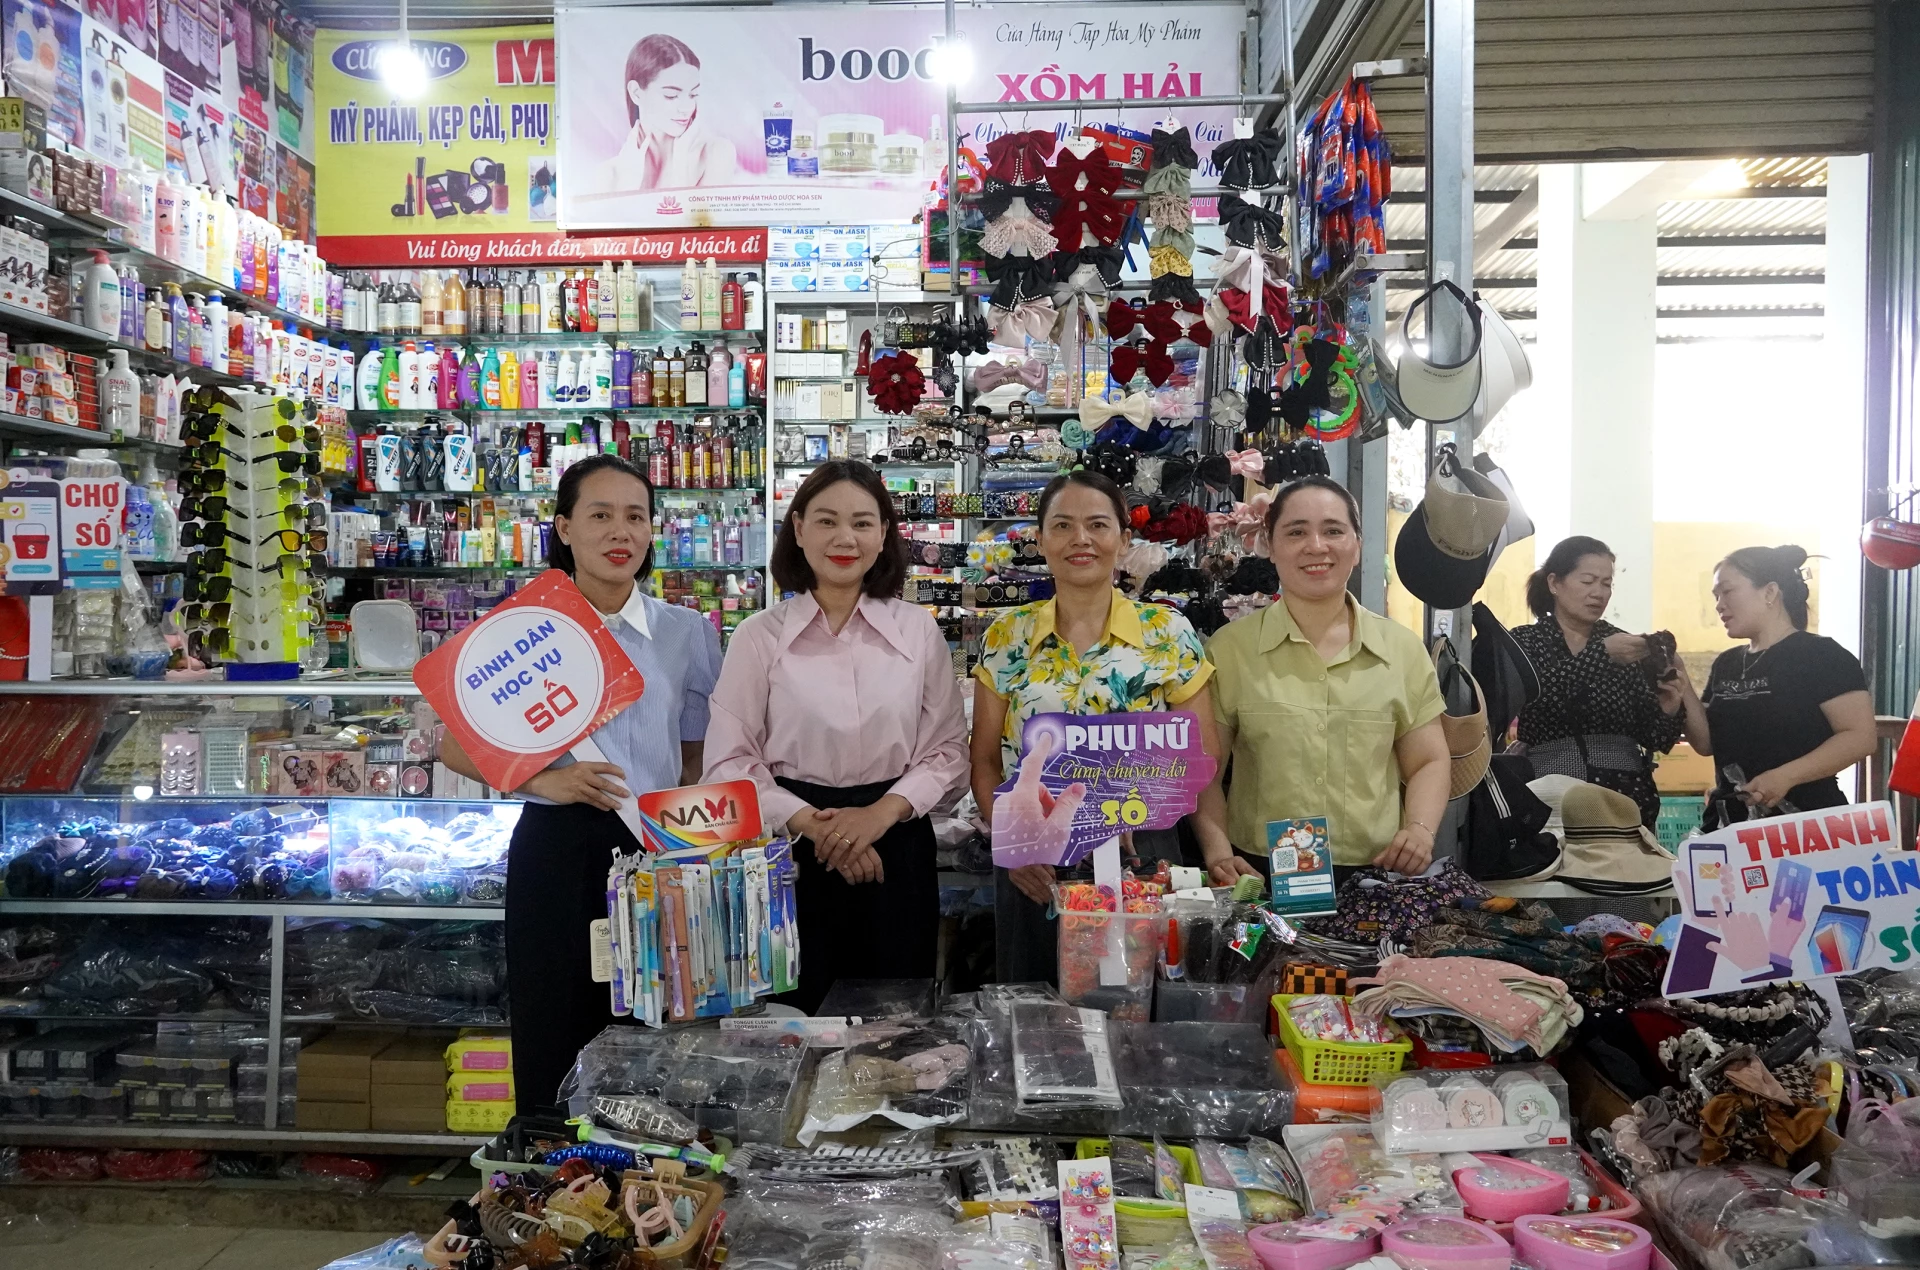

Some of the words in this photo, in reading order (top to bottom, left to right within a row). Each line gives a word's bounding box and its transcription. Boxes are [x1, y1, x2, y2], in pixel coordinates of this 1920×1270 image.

[995, 21, 1023, 43] Cửa
[1025, 22, 1063, 51] Hàng
[1068, 21, 1100, 50] Tạp
[1101, 19, 1129, 46] Hóa
[1132, 19, 1156, 48] Mỹ
[1160, 17, 1201, 43] Phẩm
[995, 63, 1106, 102] XỒM
[1123, 62, 1202, 97] HẢI
[330, 101, 358, 143] MỸ
[364, 99, 423, 145] PHẨM,
[429, 106, 463, 148] KẸP
[469, 98, 506, 144] CÀI,
[511, 104, 549, 146] PHỤ
[1195, 121, 1225, 142] Cài
[406, 240, 436, 259] Vui
[440, 239, 482, 262] lòng
[486, 238, 543, 259] khách
[547, 235, 587, 259] đến,
[592, 236, 628, 257] vừa
[631, 237, 674, 261] lòng
[678, 236, 738, 257] khách
[740, 235, 761, 254] đi
[65, 481, 120, 512] CHỢ
[75, 515, 111, 546] SỐ
[465, 649, 515, 690] BÌNH
[514, 620, 557, 655] DÂN
[490, 670, 533, 705] HỌC
[532, 648, 562, 673] VỤ
[523, 678, 578, 733] SỐ
[1065, 724, 1137, 757] PHỤ
[1143, 716, 1191, 750] NỮ
[1059, 759, 1101, 787] Cùng
[1100, 786, 1148, 826] SỐ
[1736, 807, 1891, 862] THANH
[1815, 852, 1920, 905] TOÁN
